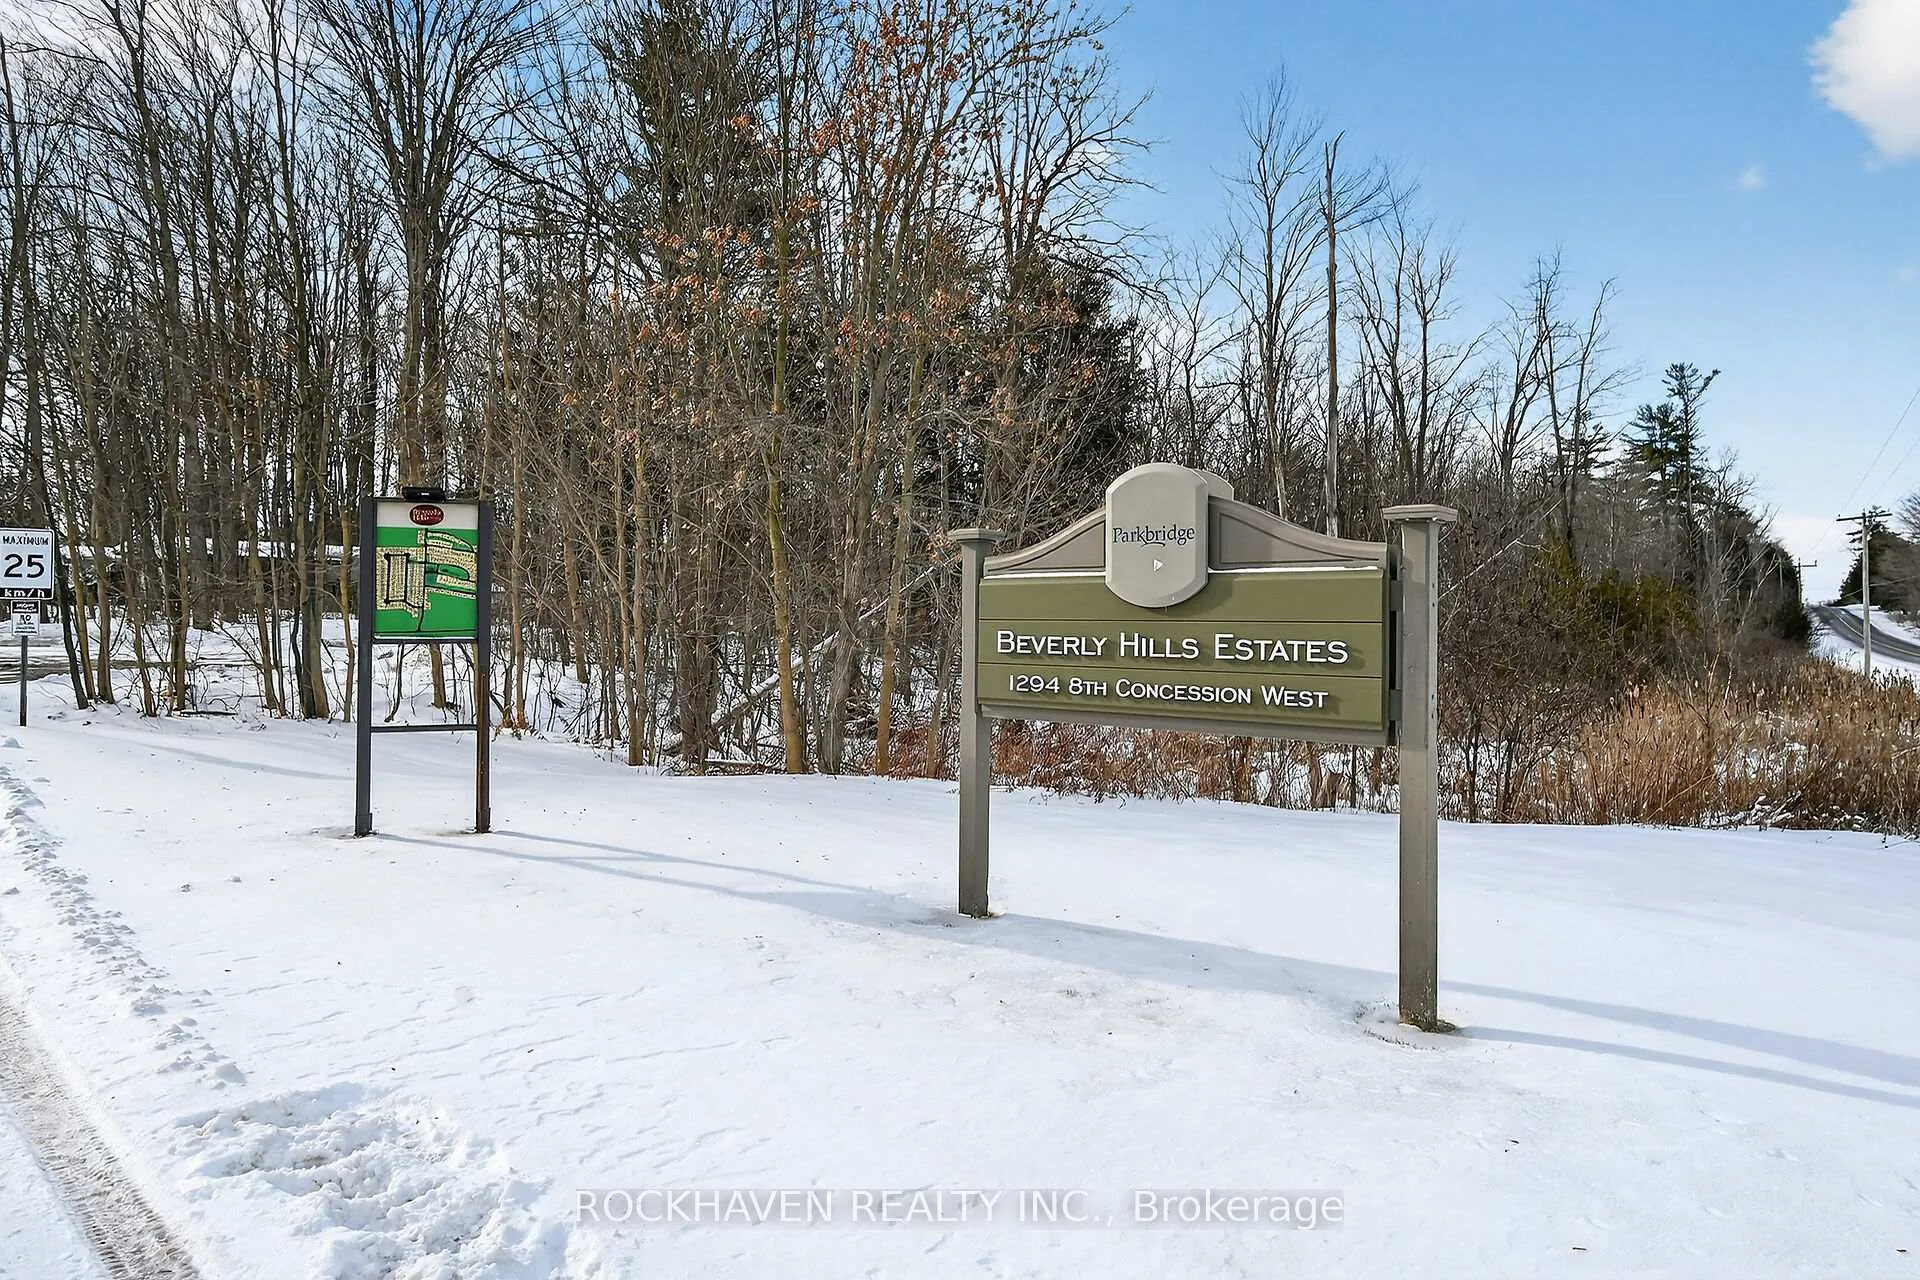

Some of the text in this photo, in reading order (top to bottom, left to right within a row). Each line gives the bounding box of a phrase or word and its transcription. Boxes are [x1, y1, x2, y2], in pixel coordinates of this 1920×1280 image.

[2, 534, 49, 545] MAXIMUM
[1112, 523, 1195, 546] Parkbridge
[4, 553, 45, 578] 25
[4, 588, 45, 598] km/h
[997, 630, 1349, 664] BEVERLY HILLS ESTATES
[1008, 674, 1329, 709] 1294 8TH CONCESSION WEST
